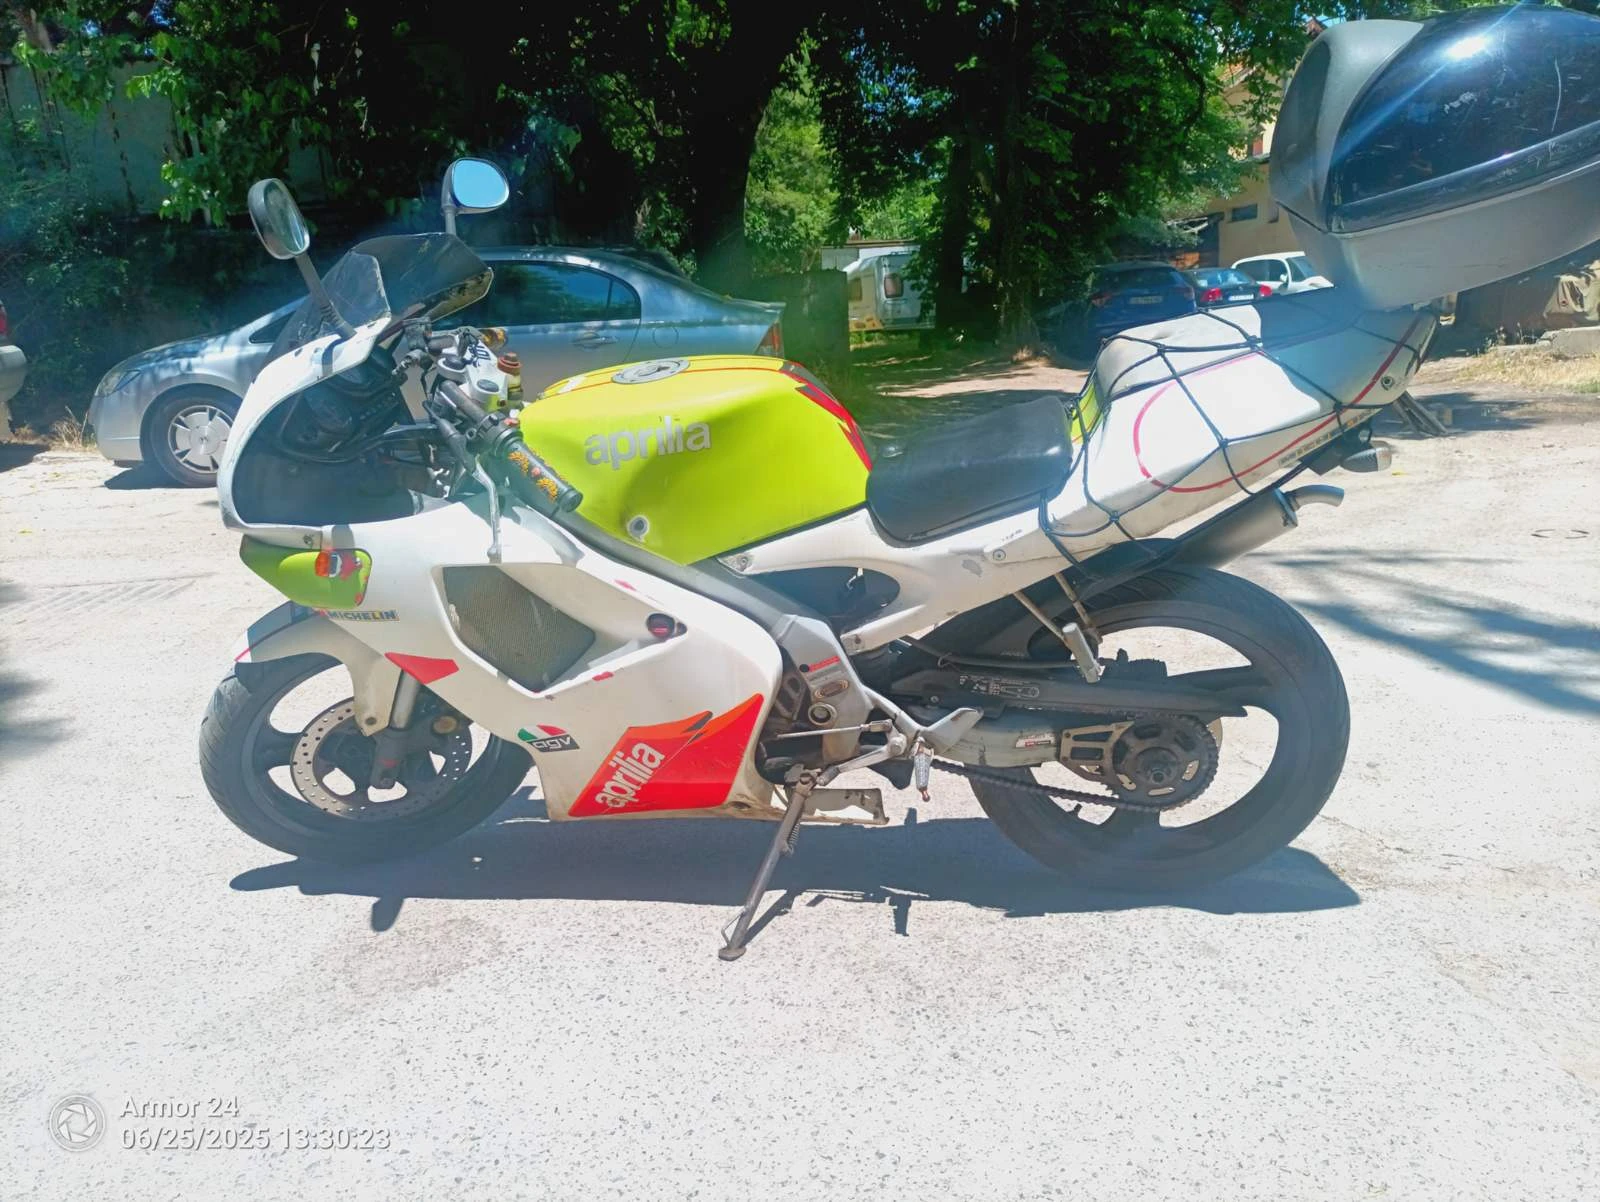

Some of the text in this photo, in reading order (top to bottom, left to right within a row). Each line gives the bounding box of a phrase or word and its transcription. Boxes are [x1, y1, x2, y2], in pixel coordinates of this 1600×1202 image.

[584, 415, 712, 471] aprilia
[327, 609, 398, 620] MICHELIN
[530, 736, 572, 750] agv
[595, 742, 666, 808] aprilia
